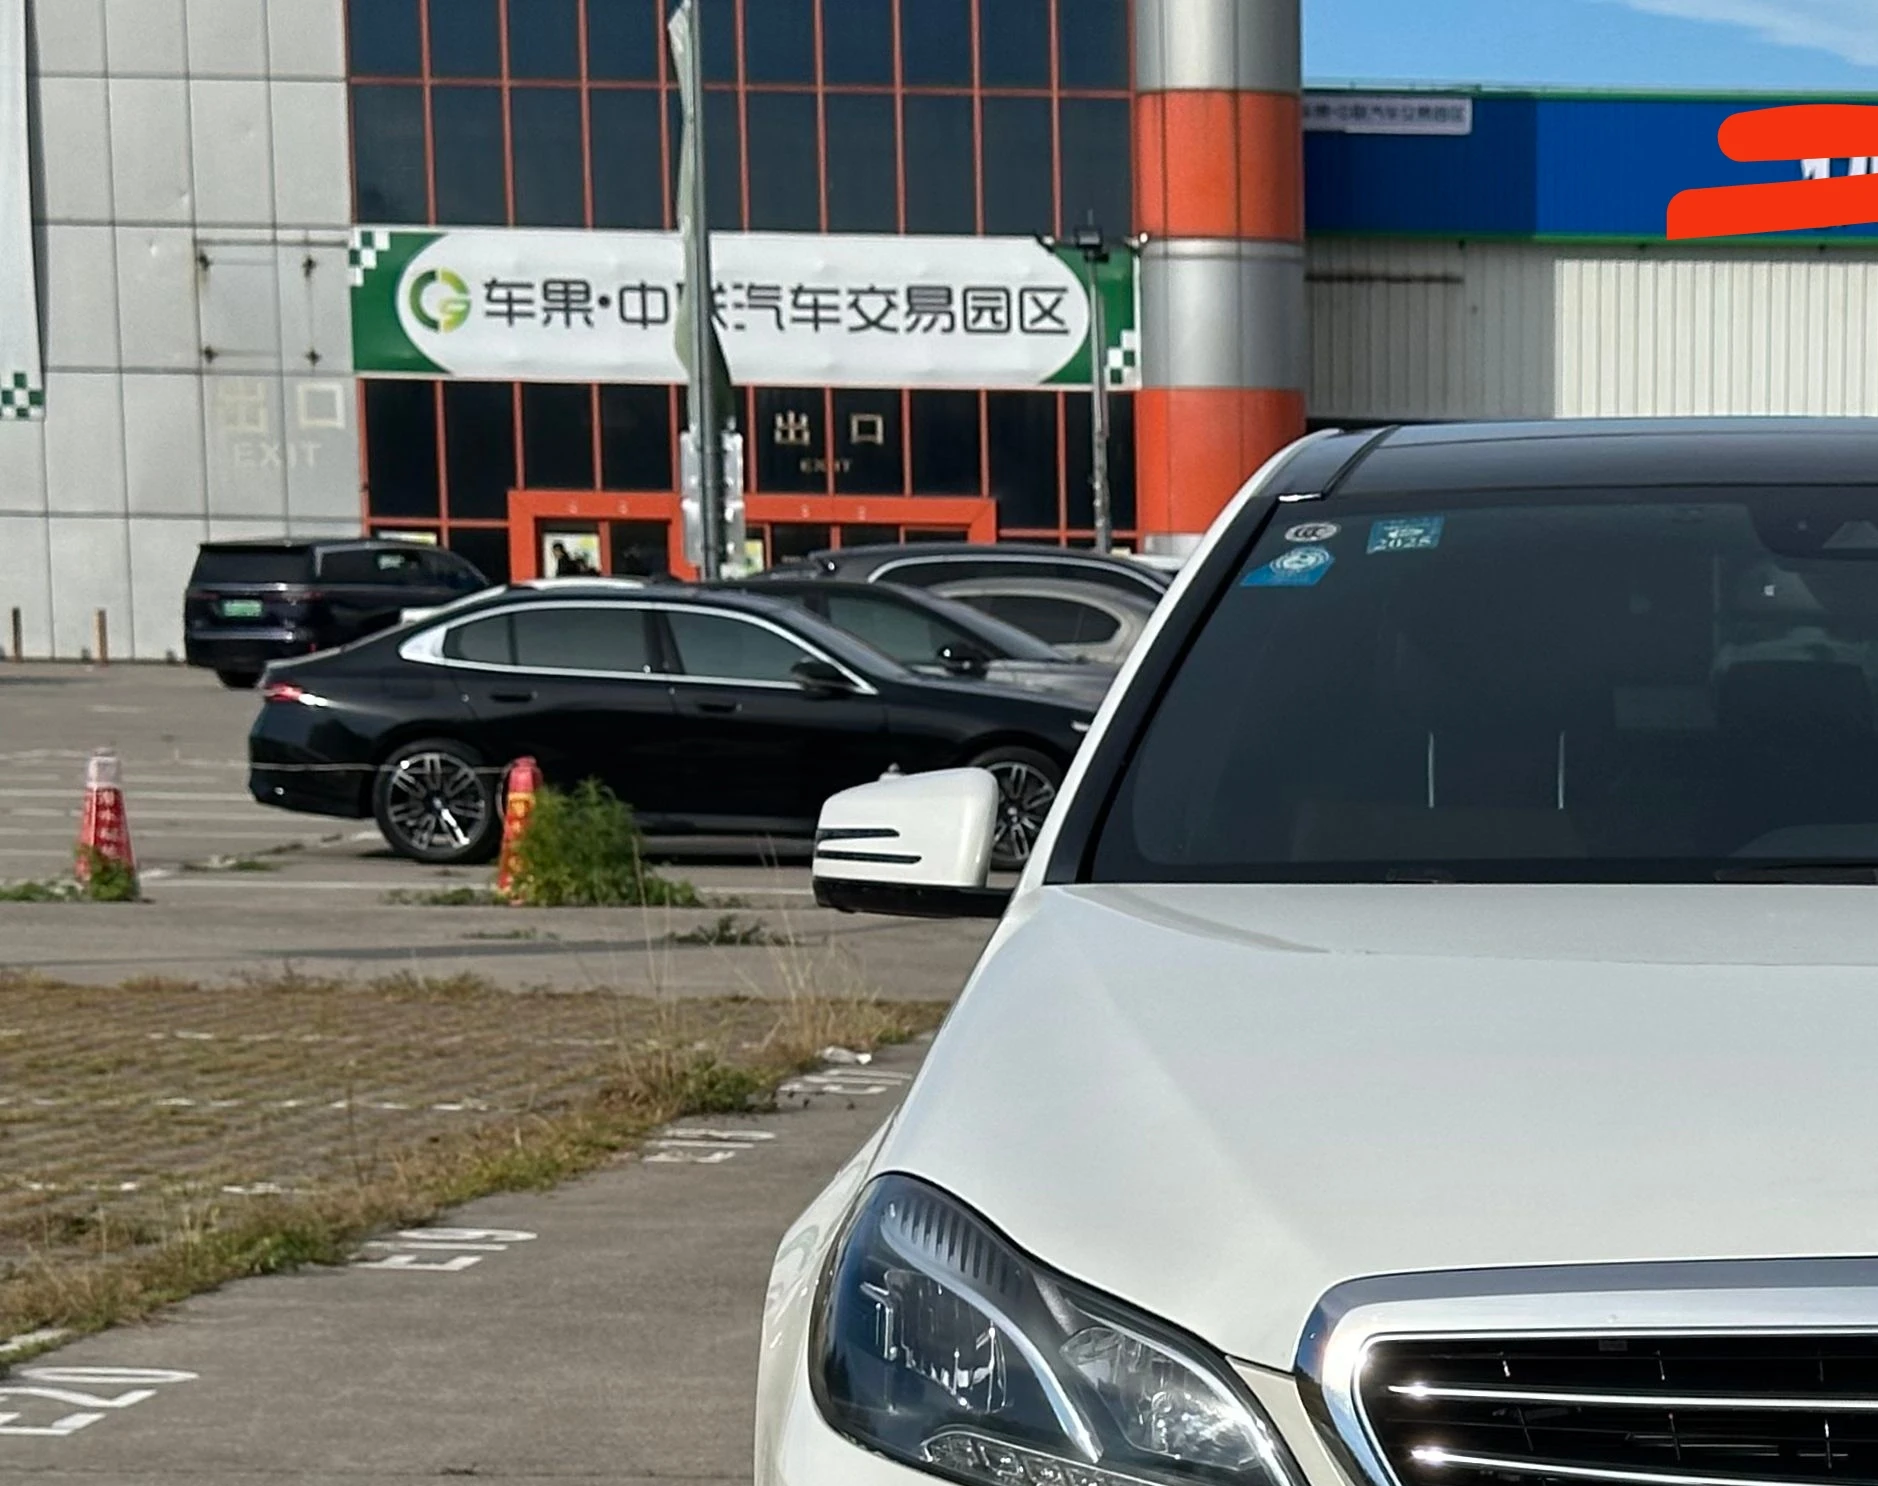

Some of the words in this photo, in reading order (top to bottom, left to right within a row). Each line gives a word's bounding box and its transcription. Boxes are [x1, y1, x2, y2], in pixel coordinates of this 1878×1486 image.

[774, 409, 884, 446] 出口
[233, 442, 322, 468] EXIT
[348, 1227, 538, 1271] E19
